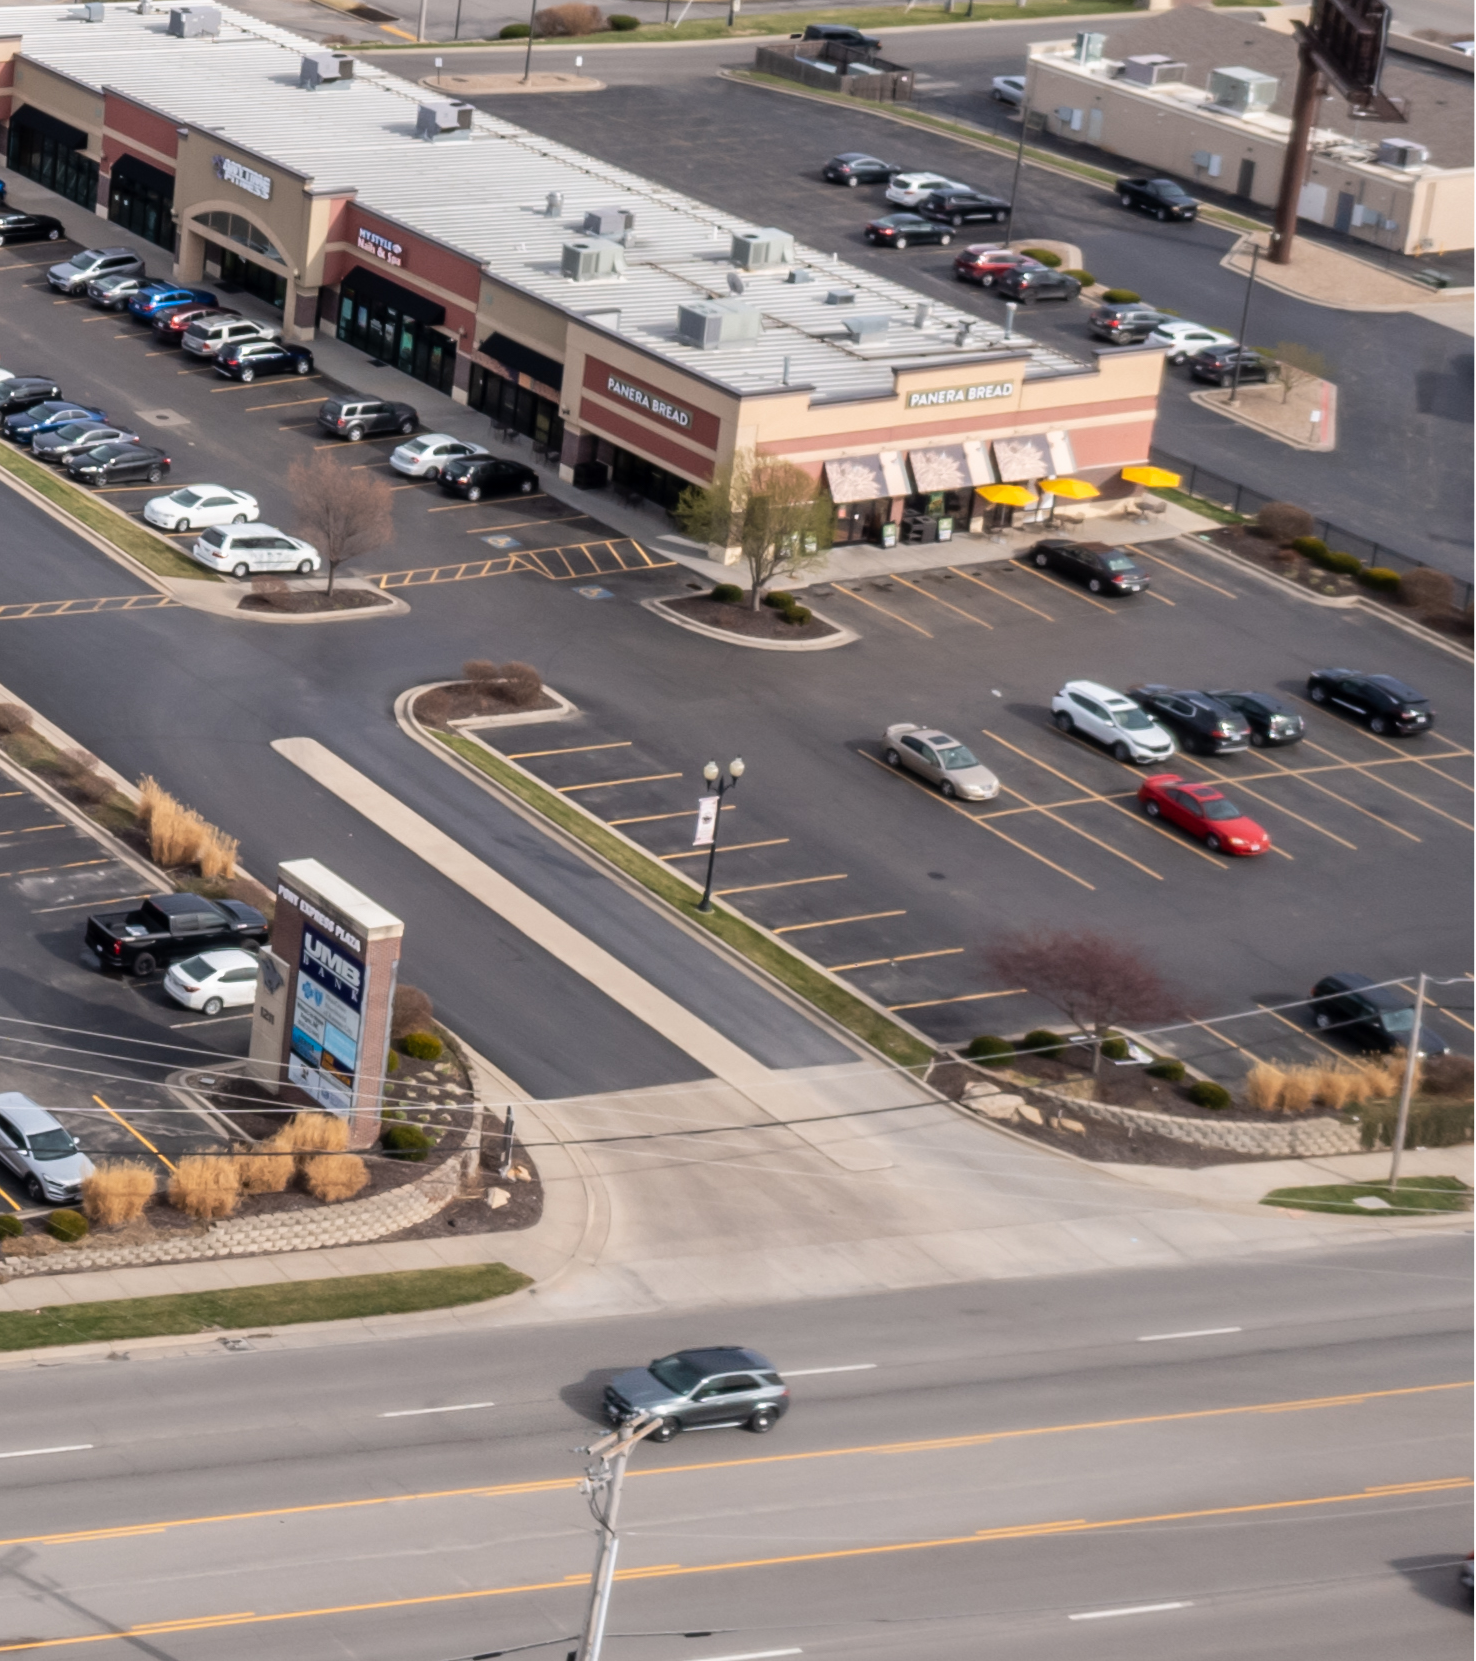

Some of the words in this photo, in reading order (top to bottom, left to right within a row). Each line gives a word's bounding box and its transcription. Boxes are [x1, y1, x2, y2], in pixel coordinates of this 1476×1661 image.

[608, 377, 650, 409] PANERA
[652, 399, 689, 426] BREAD
[910, 389, 965, 408] PANERA
[967, 383, 1013, 401] BREAD
[299, 899, 335, 933] EXPRESS
[335, 925, 361, 953] PLAZA
[302, 951, 359, 1004] BANK
[304, 932, 361, 987] UMB
